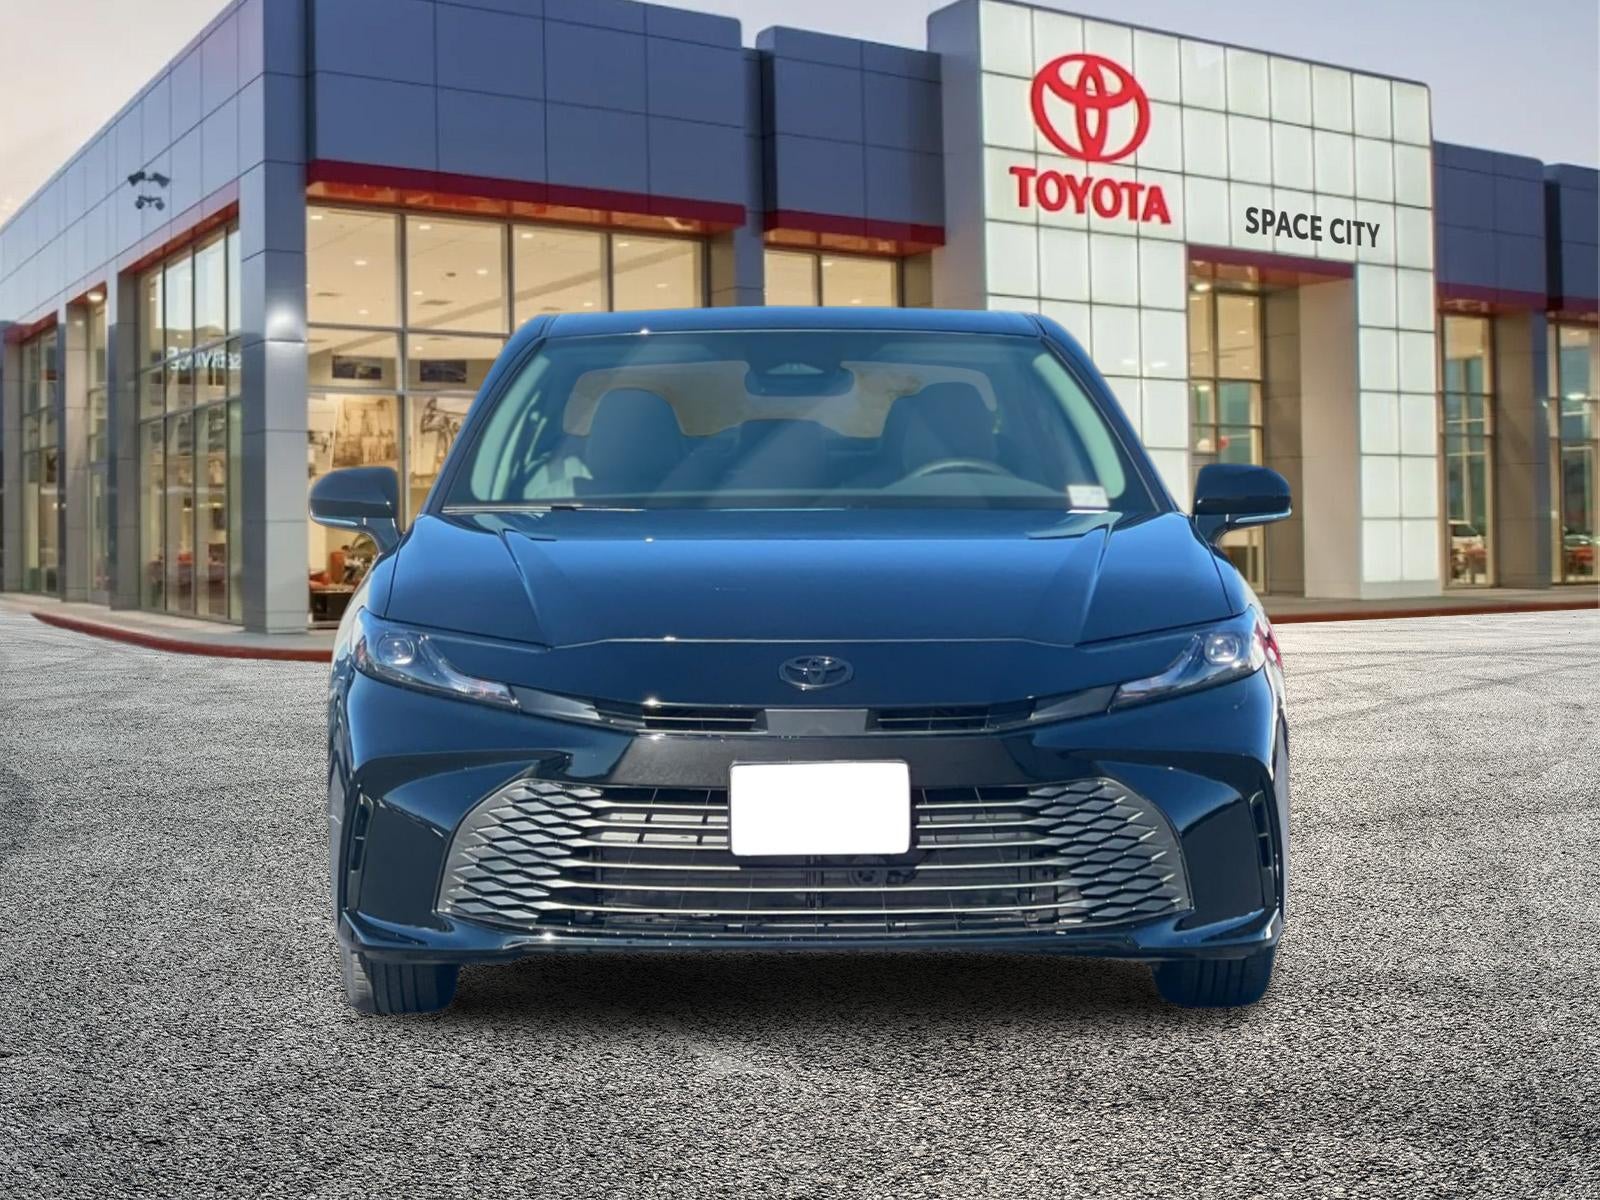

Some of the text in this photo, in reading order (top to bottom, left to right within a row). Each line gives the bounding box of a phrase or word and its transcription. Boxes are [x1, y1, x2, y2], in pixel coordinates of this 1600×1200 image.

[1009, 166, 1171, 224] TOYOTA
[1245, 206, 1380, 248] SPACE CITY
